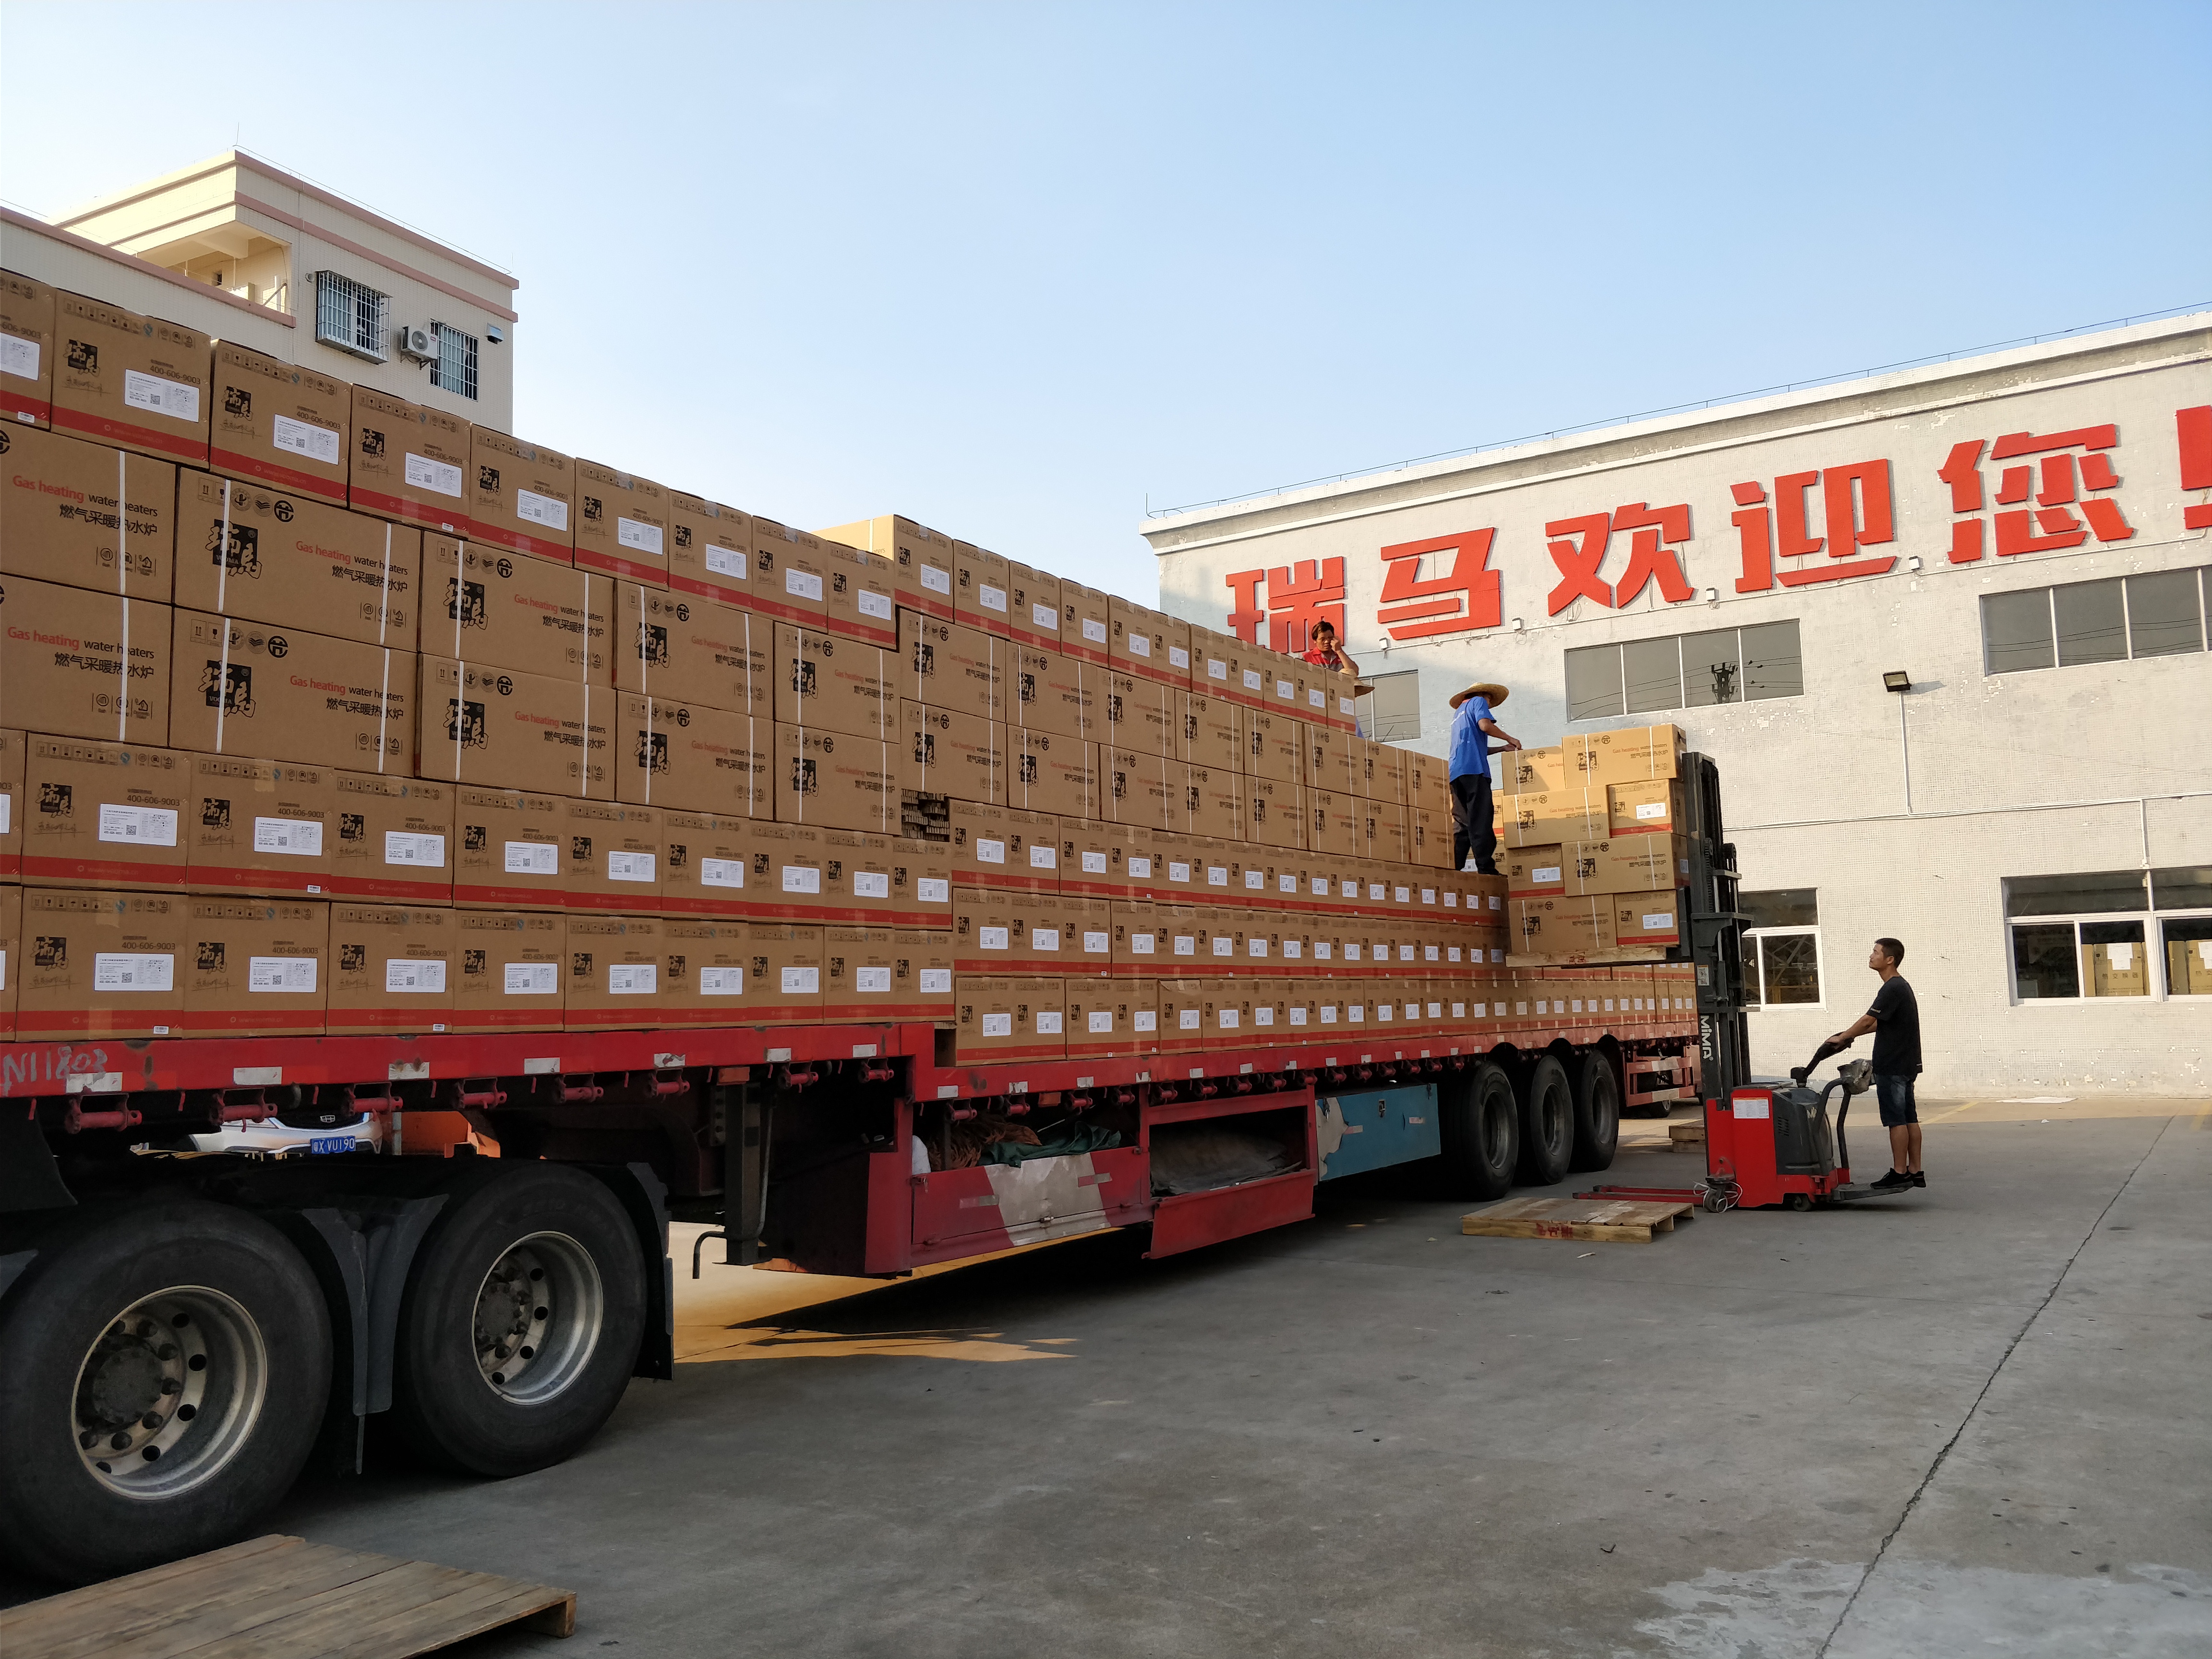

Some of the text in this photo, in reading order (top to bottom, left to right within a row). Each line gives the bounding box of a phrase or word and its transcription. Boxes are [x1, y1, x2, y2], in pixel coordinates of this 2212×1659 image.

[150, 366, 200, 385] 400-606-9003
[297, 411, 340, 429] 400-606-9003
[424, 448, 463, 464] 400-606-9003
[13, 476, 35, 490] Gas
[39, 482, 84, 503] heating
[89, 495, 118, 507] water
[534, 485, 568, 500] 400-606-9003
[60, 503, 157, 536] 燃气采暖热水炉
[296, 541, 408, 575] Gas heating water haters
[332, 564, 408, 590] 燃气采暖热水炉
[515, 594, 603, 622] Gas heating water haters
[543, 614, 603, 636] 燃气采暖热水炉
[8, 627, 154, 659] Gas heating water haters
[692, 636, 703, 646] Gas
[705, 638, 727, 653] heating
[730, 645, 745, 654] water
[55, 651, 154, 678] 燃气采暖热水炉
[290, 676, 307, 686] Gas
[311, 679, 346, 695] heating
[349, 687, 372, 697] water
[326, 697, 404, 719] 燃气采暖热水炉
[516, 712, 529, 721] Gas
[531, 715, 559, 727] heating
[544, 729, 606, 748] 燃气采暖热水炉
[692, 740, 765, 758] Gas heating water haters
[127, 795, 180, 806] 400-606-9003
[277, 808, 324, 818] 400-606-9003
[405, 822, 445, 832] 400-606-9003
[522, 833, 558, 842] 400-606-9003
